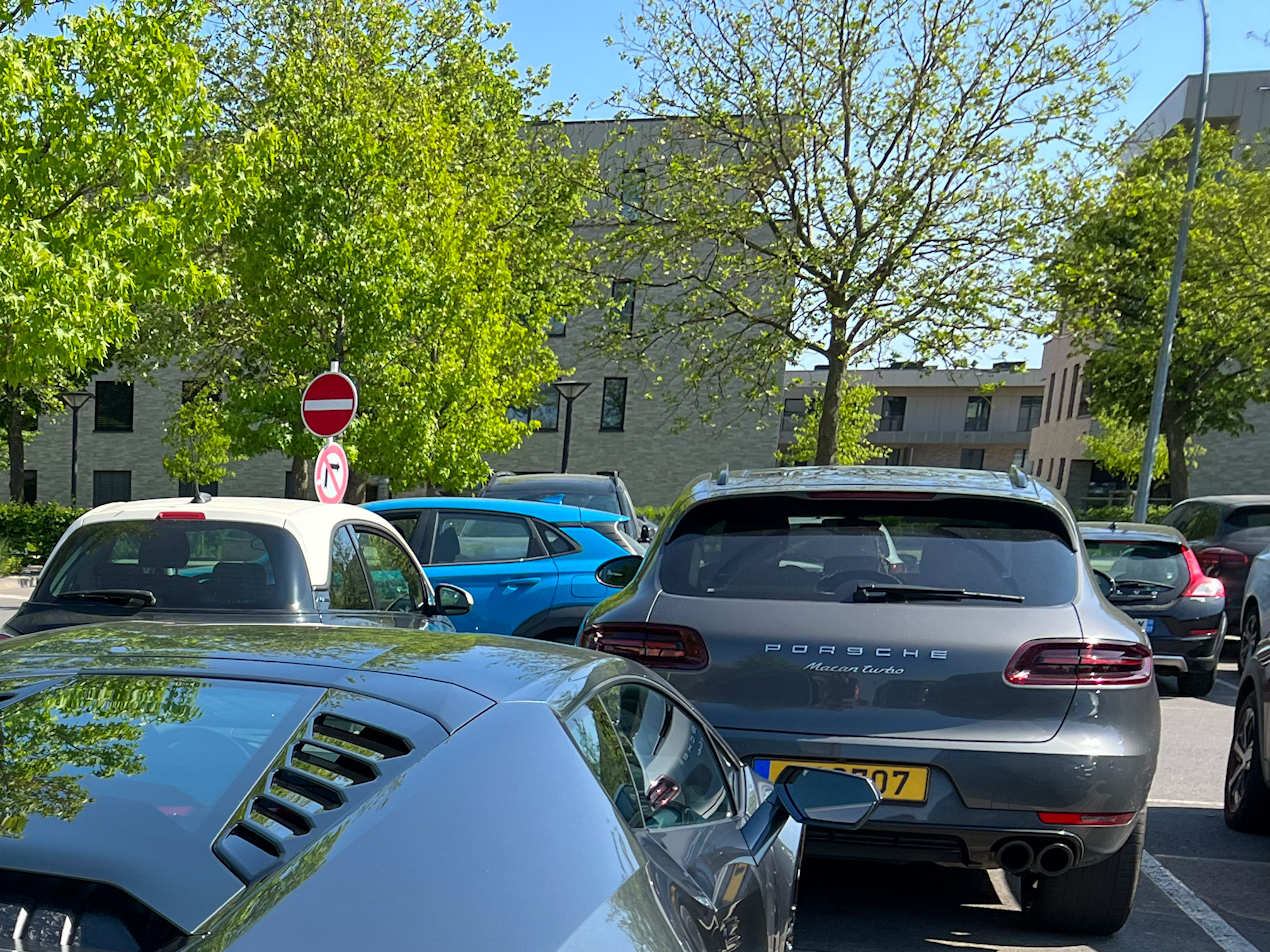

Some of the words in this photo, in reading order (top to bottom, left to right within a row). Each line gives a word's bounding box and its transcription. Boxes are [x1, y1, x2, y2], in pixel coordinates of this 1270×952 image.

[764, 643, 949, 660] PORSCHE
[803, 661, 859, 674] Macan
[861, 664, 906, 675] turbo
